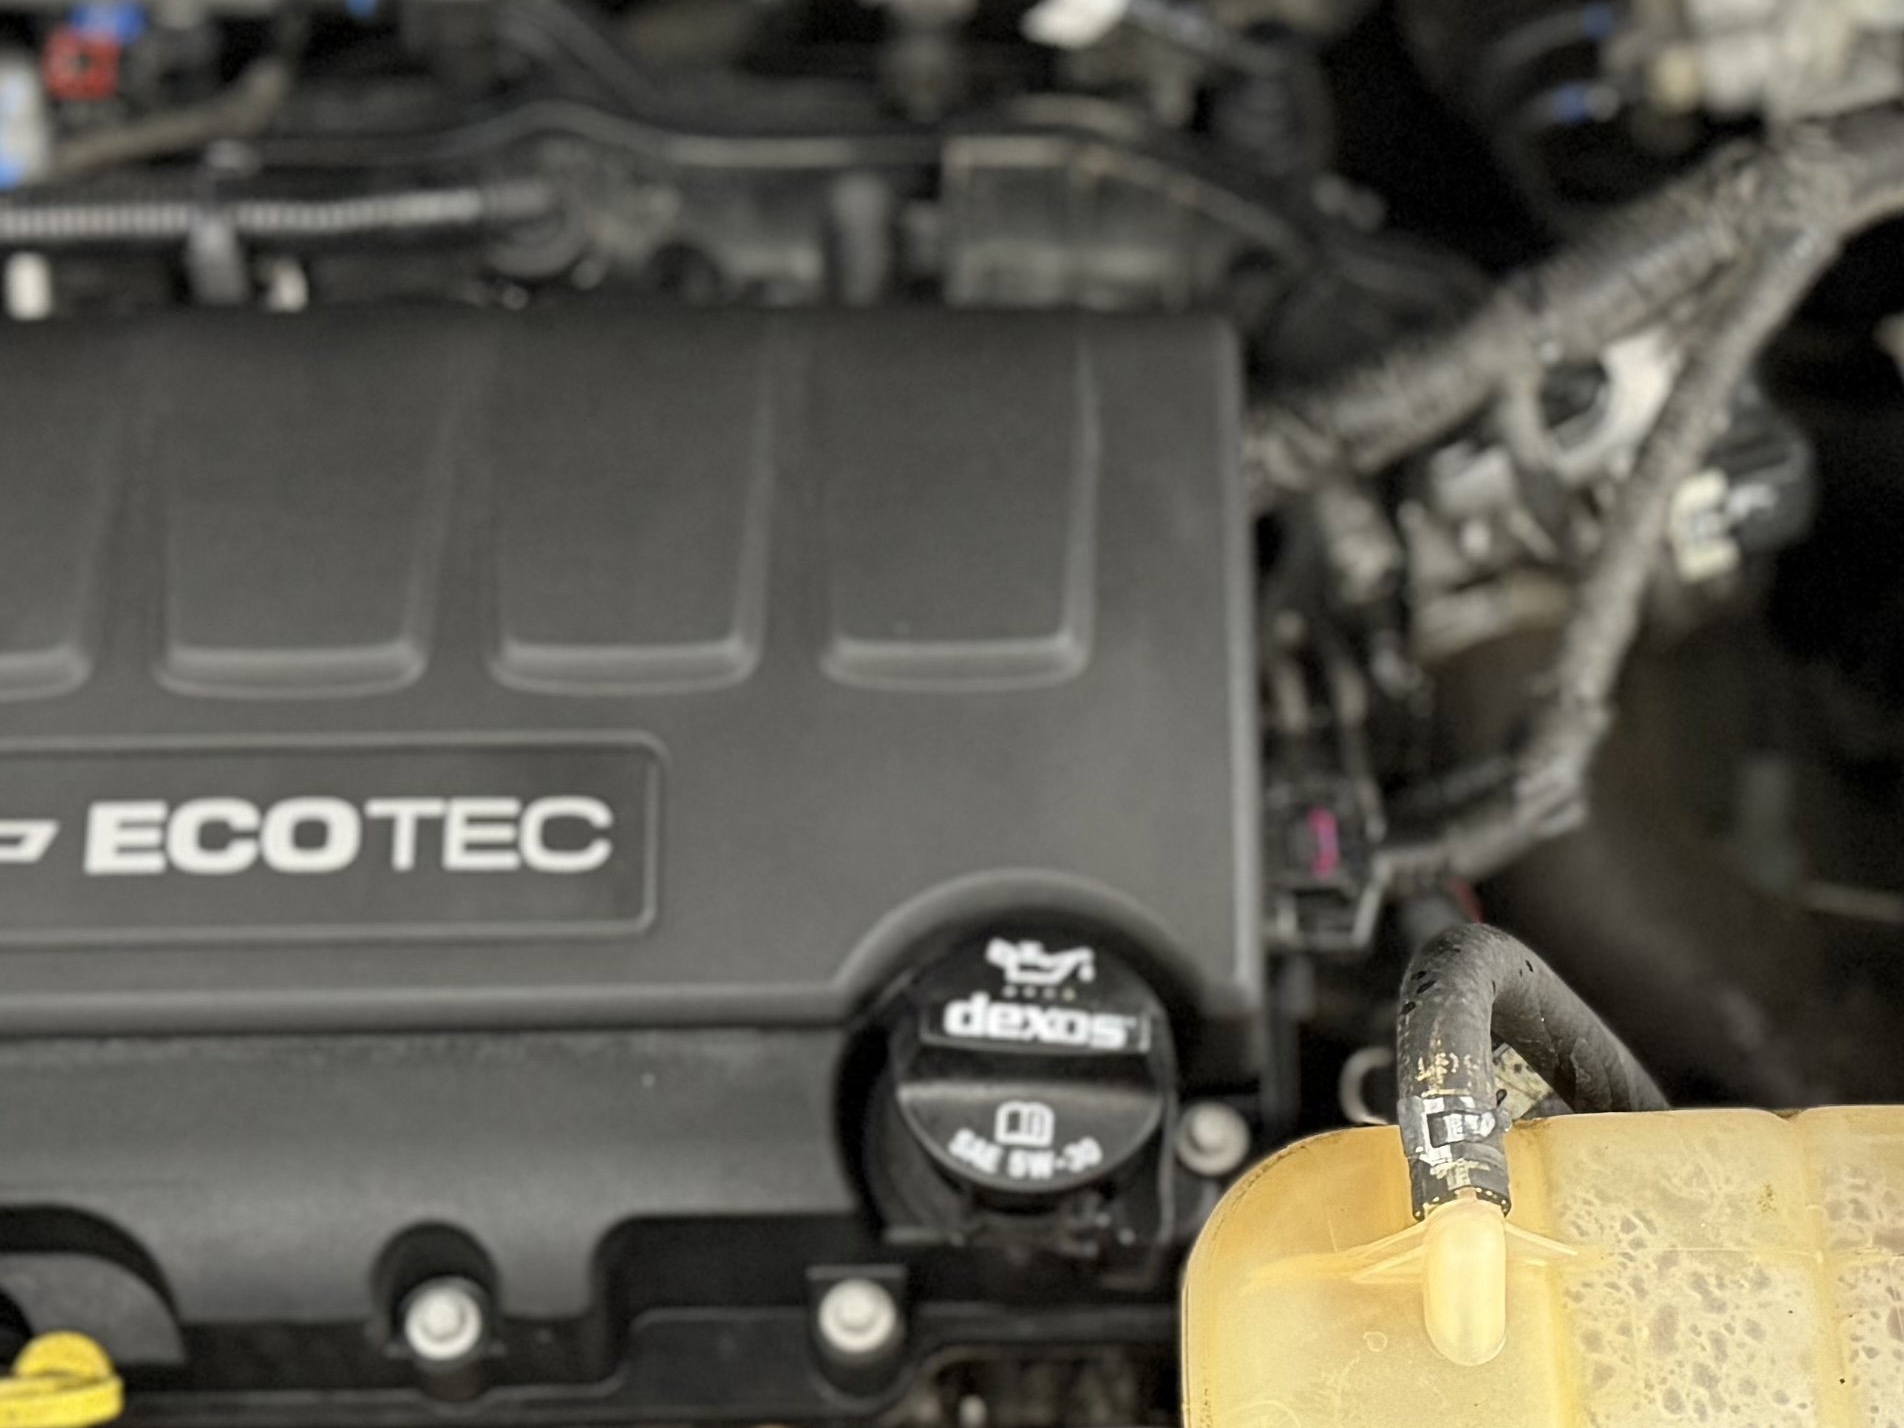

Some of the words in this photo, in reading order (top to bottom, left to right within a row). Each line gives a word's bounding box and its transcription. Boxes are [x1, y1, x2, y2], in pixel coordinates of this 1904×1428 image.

[82, 796, 613, 876] ECOTEC
[943, 991, 1129, 1050] dexos
[948, 1128, 1003, 1175] SAE
